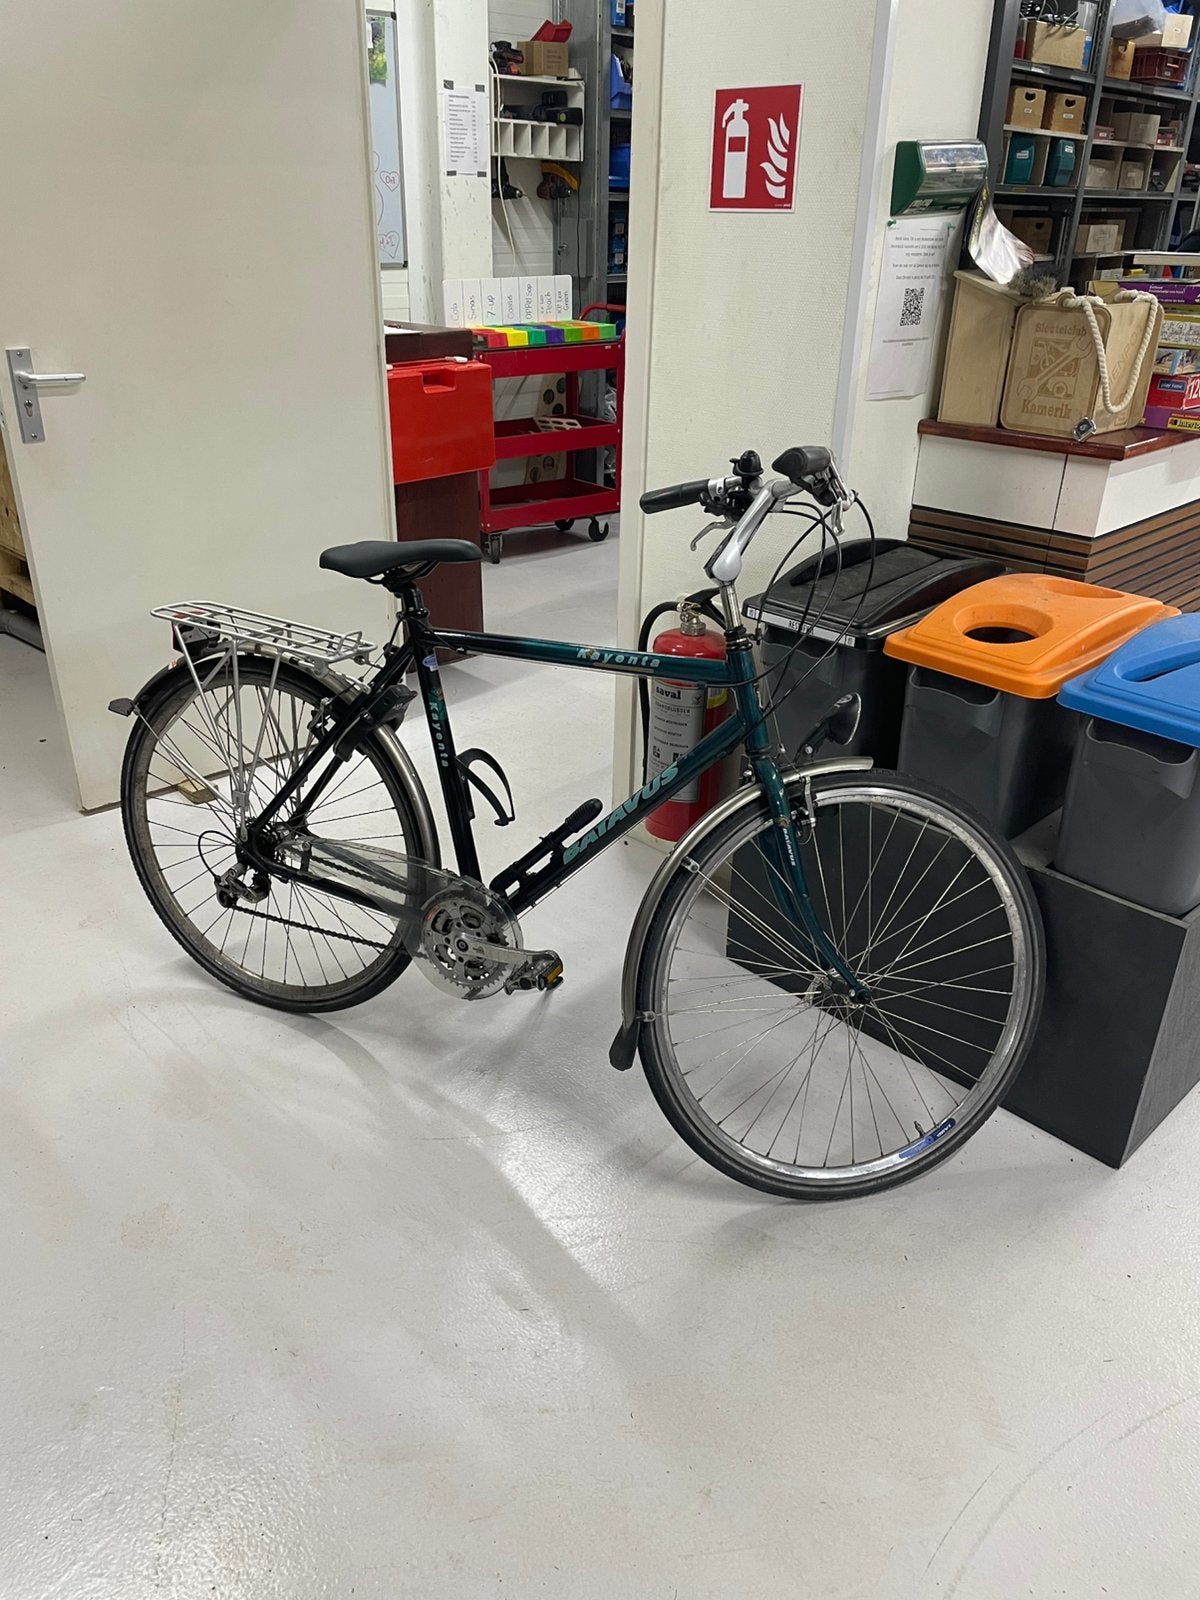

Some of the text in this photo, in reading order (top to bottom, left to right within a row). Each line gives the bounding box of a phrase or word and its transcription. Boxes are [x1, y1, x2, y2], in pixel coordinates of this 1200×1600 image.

[1021, 399, 1073, 419] Kamerik
[576, 648, 660, 667] Kayenta
[655, 686, 681, 700] saval
[428, 702, 449, 767] Kayenta
[562, 761, 679, 865] BATAVUS
[782, 828, 796, 867] BATAVUS
